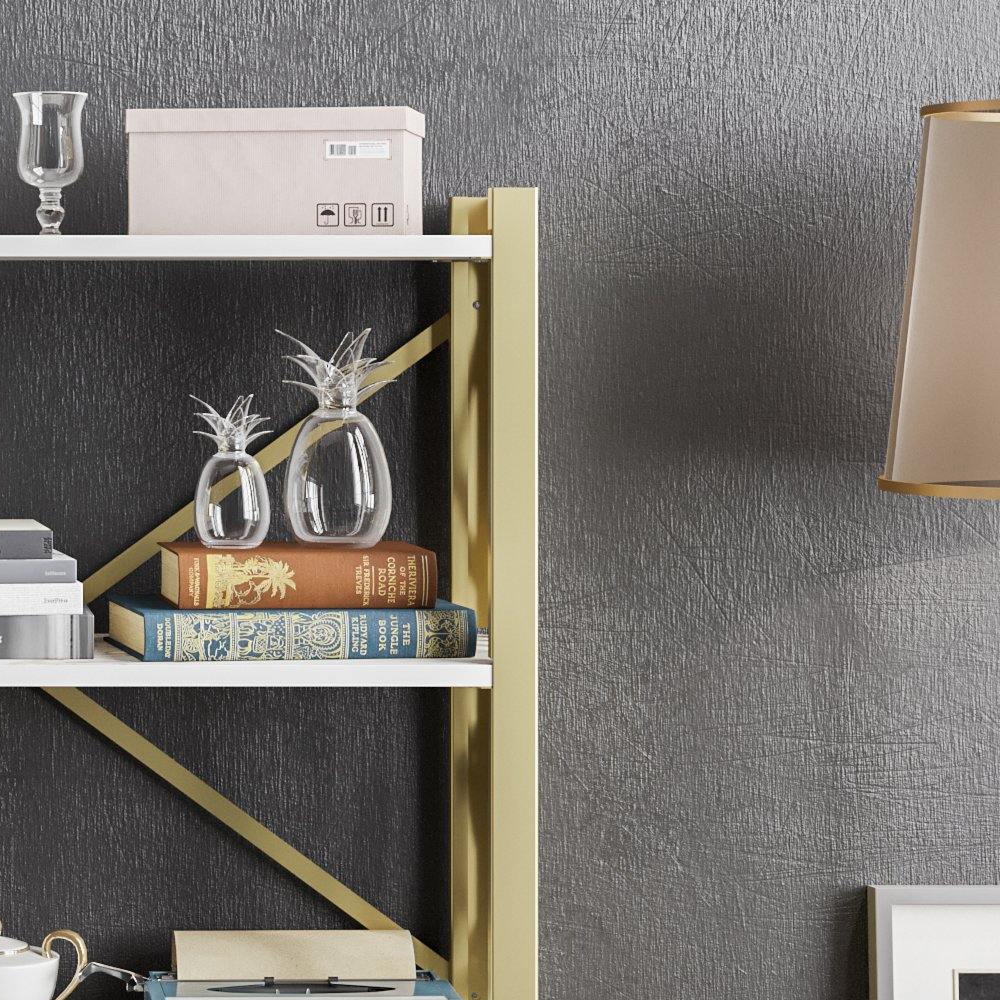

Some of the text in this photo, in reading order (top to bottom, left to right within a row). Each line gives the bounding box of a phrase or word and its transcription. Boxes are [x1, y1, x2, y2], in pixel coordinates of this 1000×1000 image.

[362, 555, 371, 606] SIR FREDERICK
[378, 568, 387, 597] ROAD
[387, 556, 397, 604] CORNICHE
[399, 566, 406, 577] OF
[407, 555, 417, 606] THE RIVIERA
[351, 616, 359, 653] KIPLING
[360, 614, 368, 656] RUDYARD
[378, 620, 387, 652] BOOK
[390, 614, 399, 655] JUNGLE
[402, 622, 411, 646] THE
